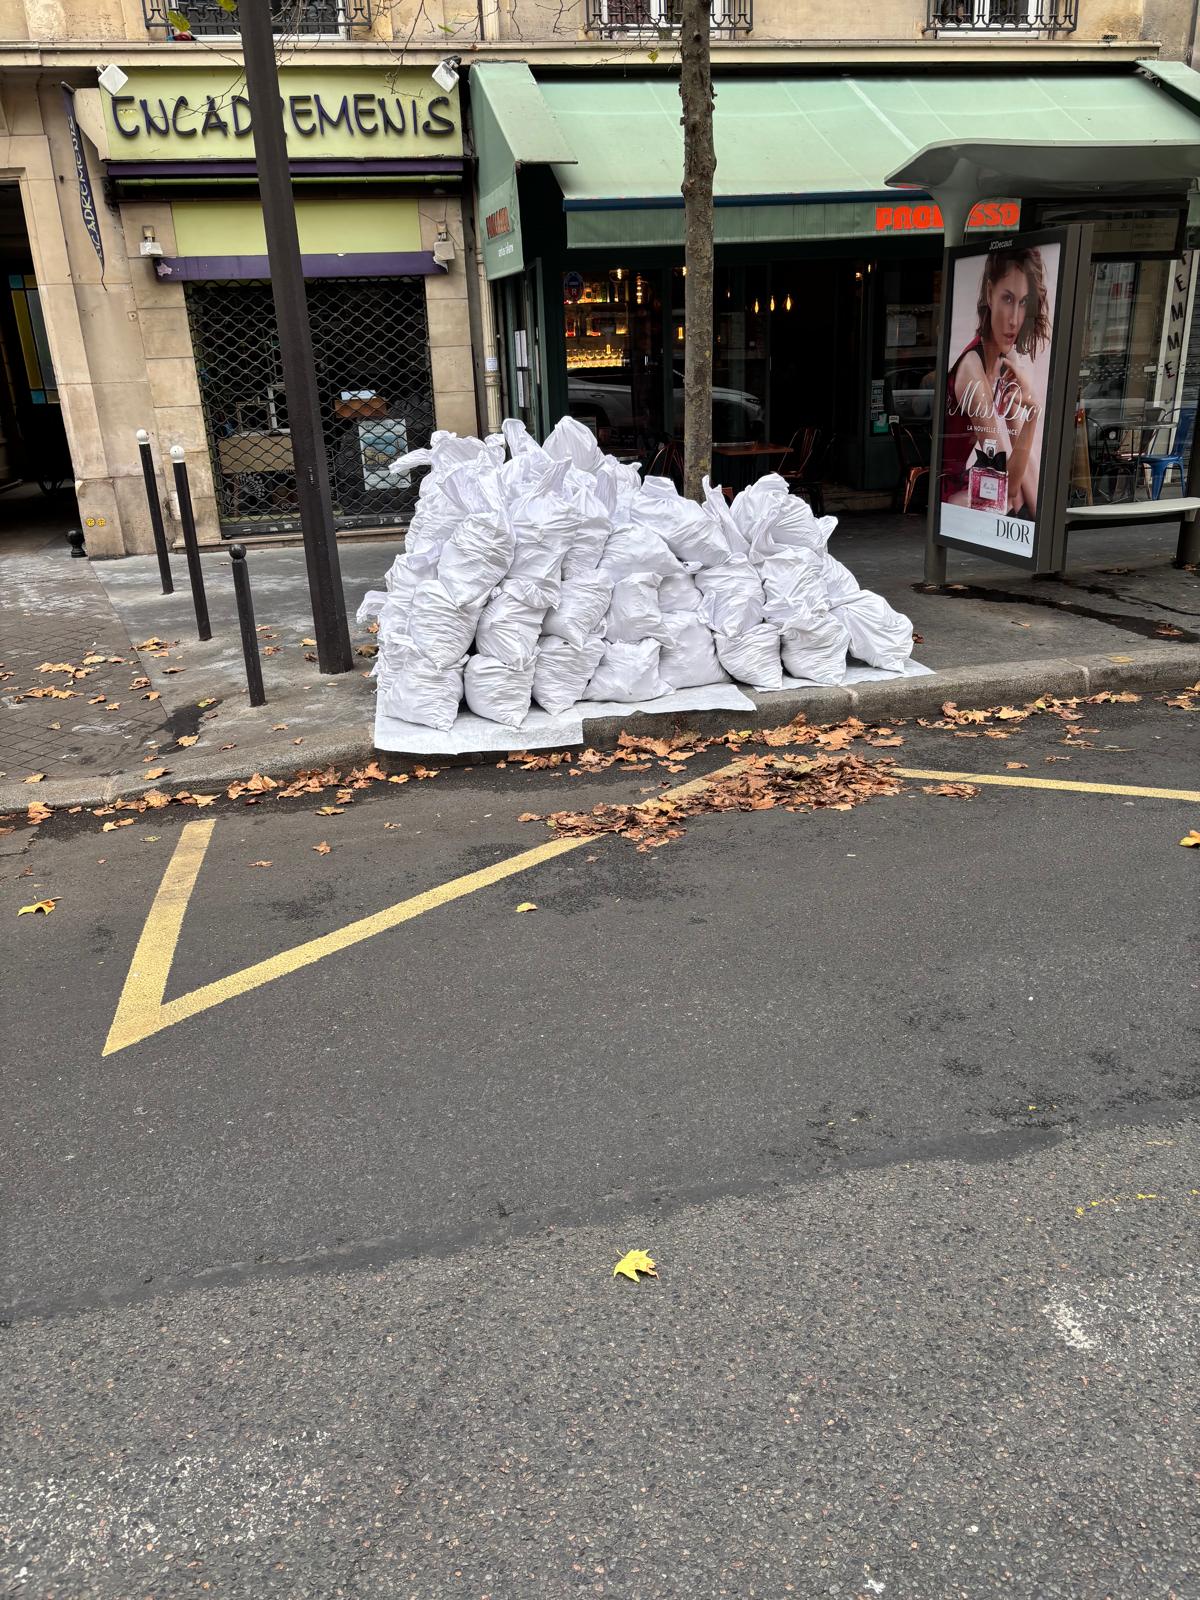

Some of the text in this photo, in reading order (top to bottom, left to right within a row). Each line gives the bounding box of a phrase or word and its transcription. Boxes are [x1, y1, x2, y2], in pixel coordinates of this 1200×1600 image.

[989, 240, 1013, 250] JCDecaux
[948, 380, 1042, 421] Miss Dior
[996, 519, 1030, 545] DIOR
